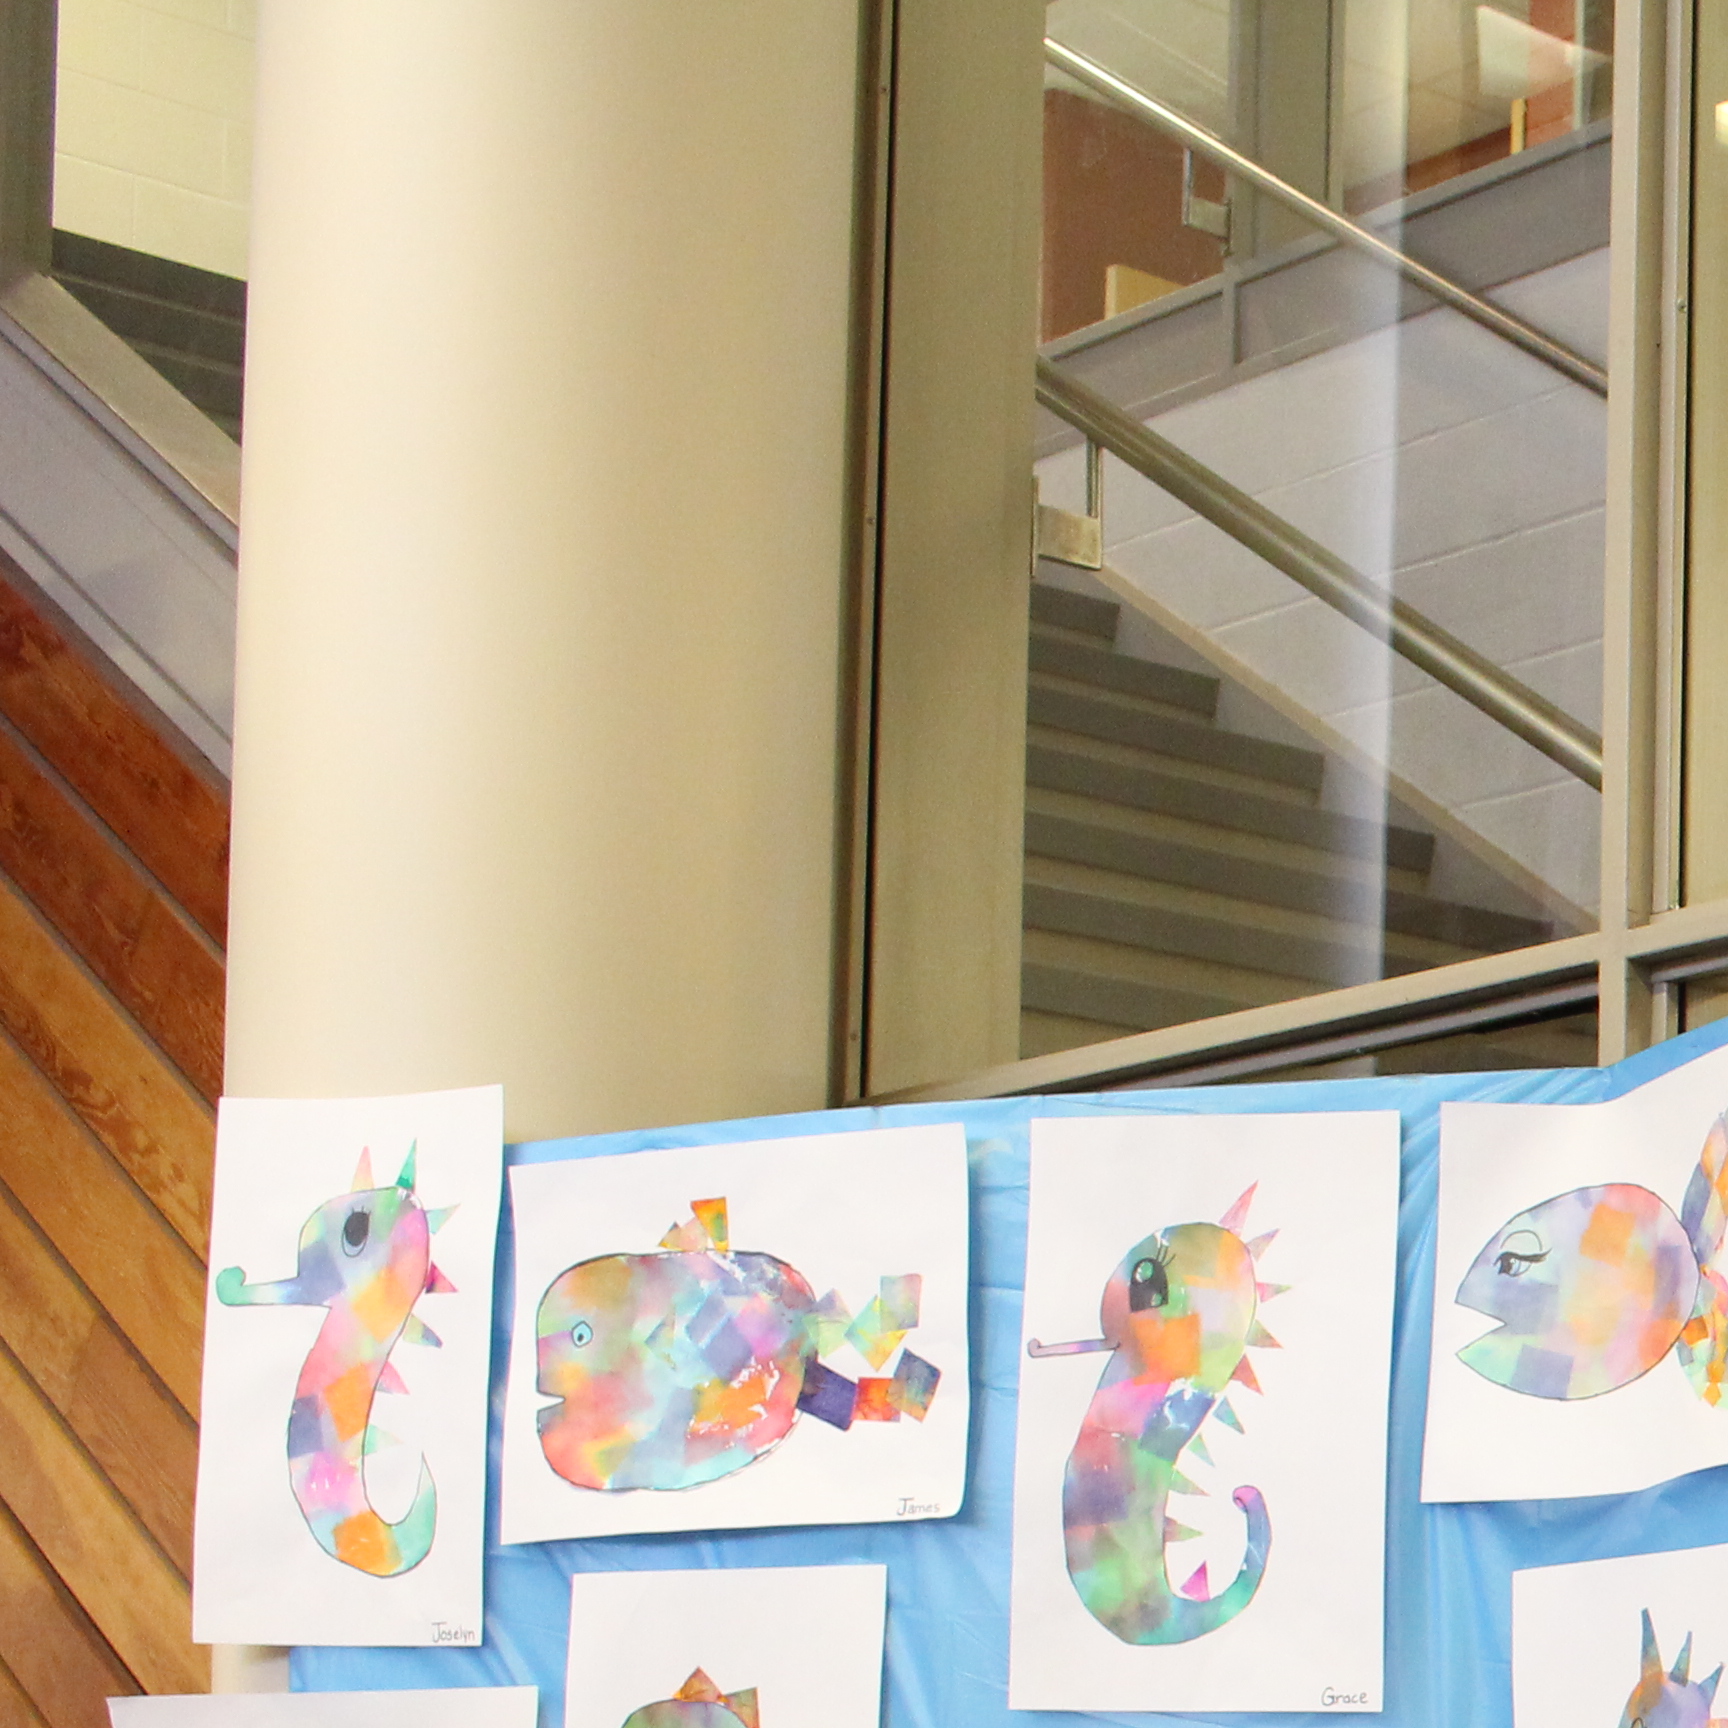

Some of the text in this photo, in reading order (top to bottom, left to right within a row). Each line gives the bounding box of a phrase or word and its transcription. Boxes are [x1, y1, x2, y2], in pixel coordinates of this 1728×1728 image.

[897, 1497, 941, 1517] James
[432, 1622, 476, 1645] Joselyn
[1321, 1686, 1368, 1707] Grace
